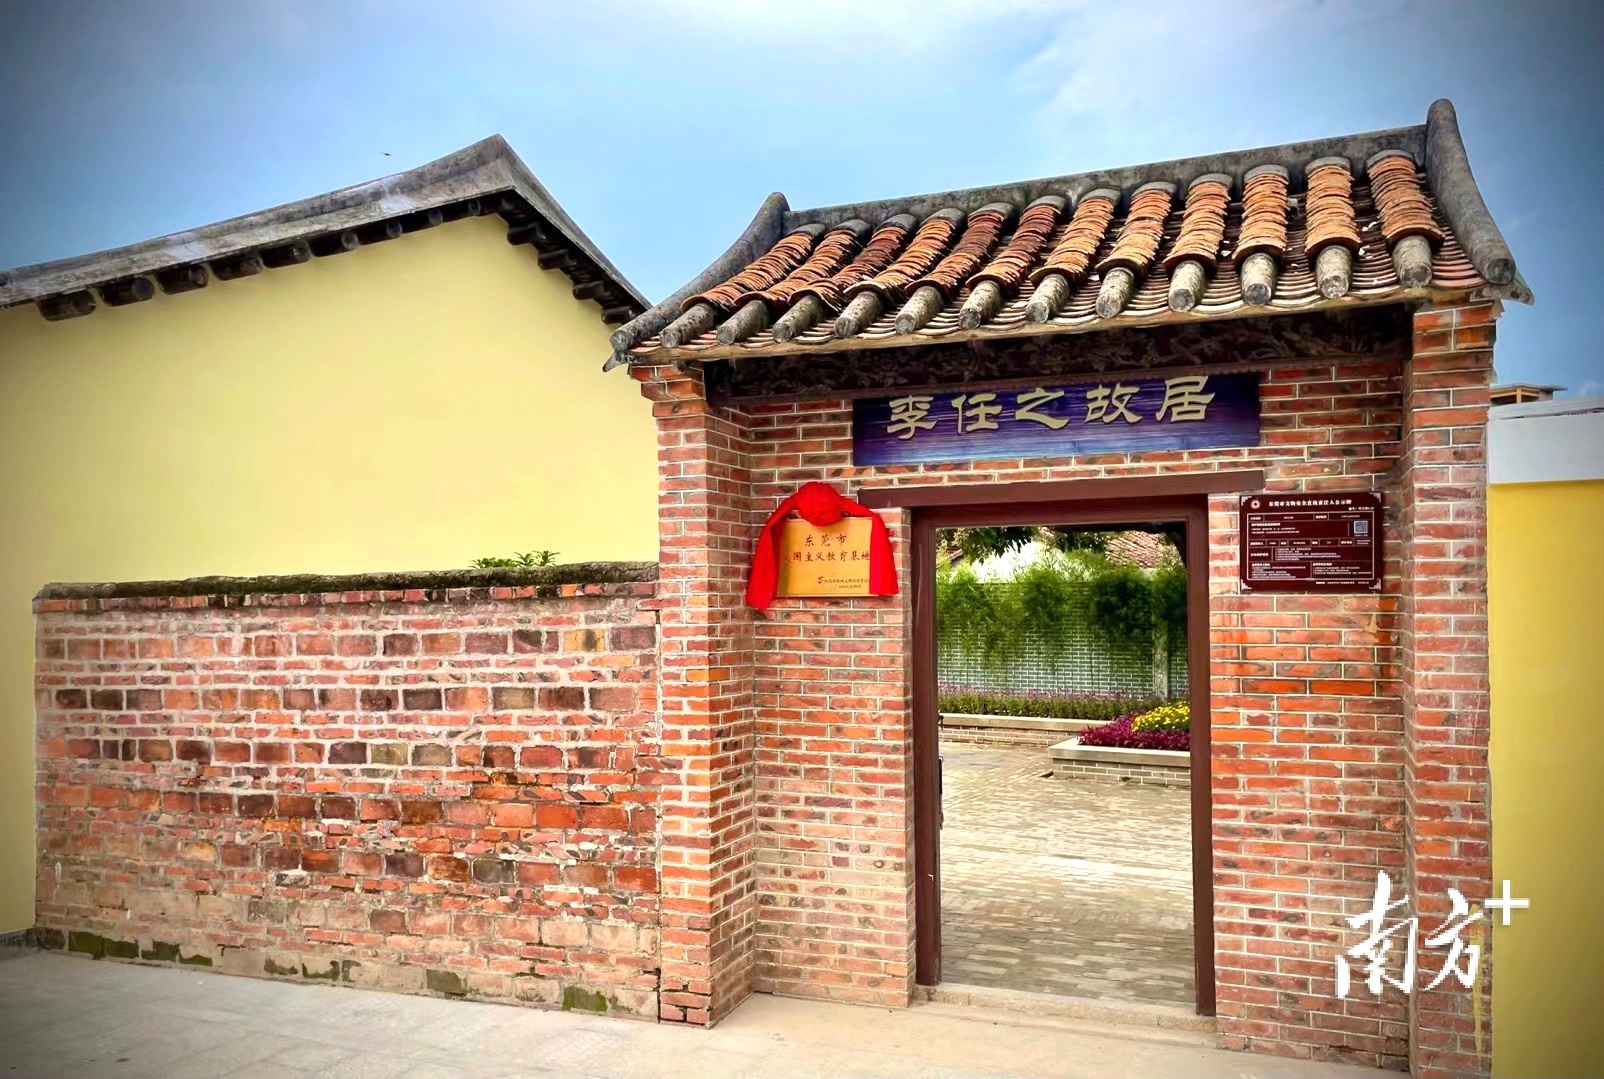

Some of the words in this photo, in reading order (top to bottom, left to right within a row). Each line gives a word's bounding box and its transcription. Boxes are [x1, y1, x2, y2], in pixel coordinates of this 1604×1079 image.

[886, 375, 1216, 440] 李任之故居
[804, 533, 848, 548] 东莞市
